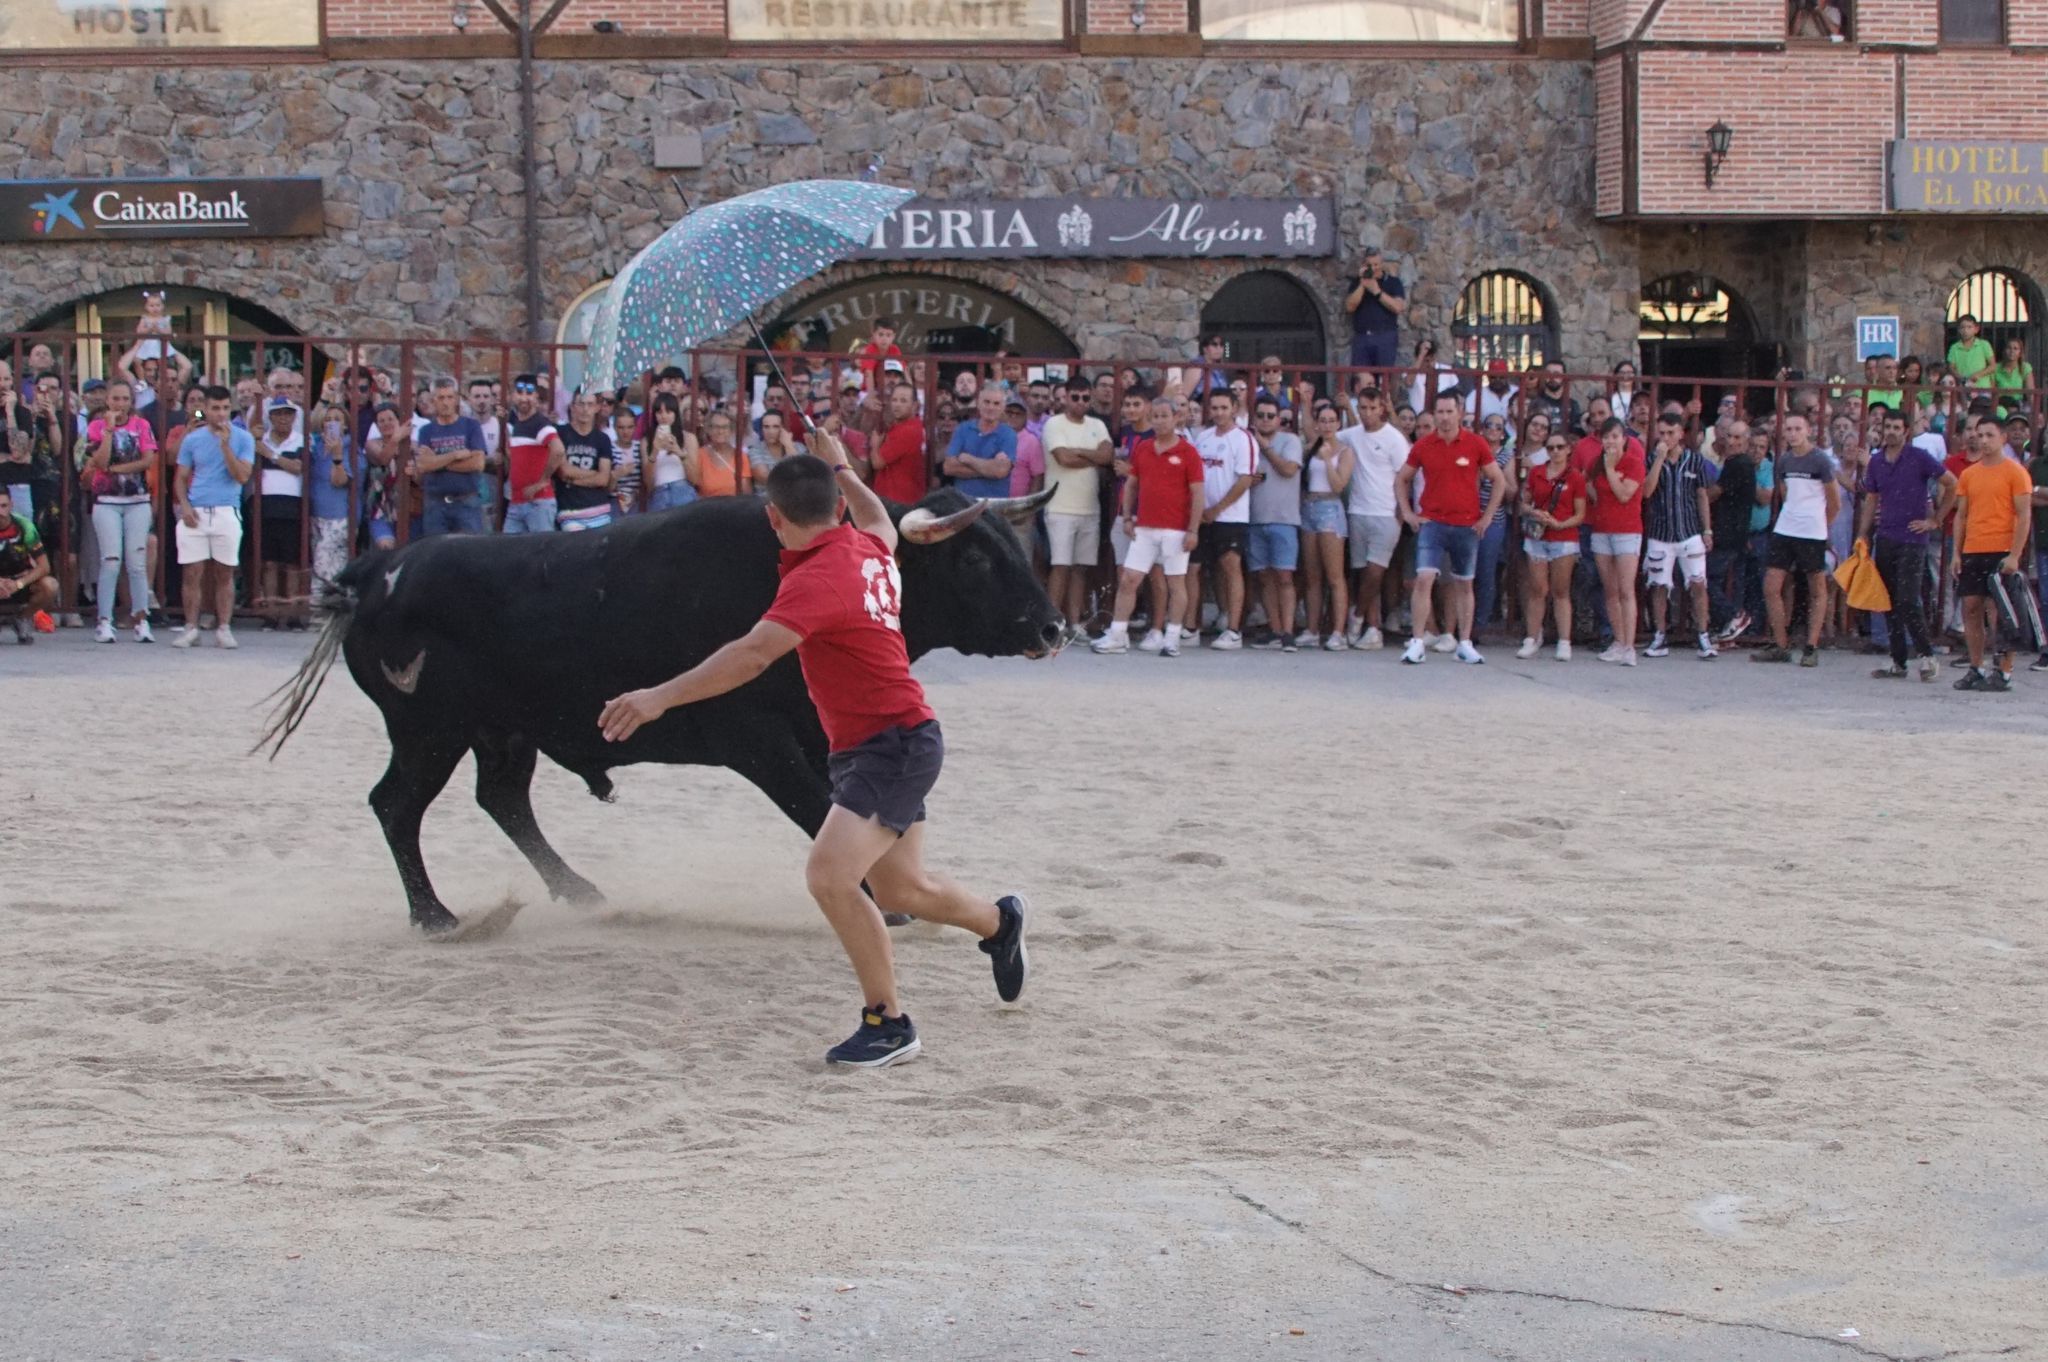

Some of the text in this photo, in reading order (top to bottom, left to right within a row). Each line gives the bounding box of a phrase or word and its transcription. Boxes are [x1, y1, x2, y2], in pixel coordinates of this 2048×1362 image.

[74, 8, 221, 34] HOSTAL
[764, 1, 1028, 28] RESTAURANTE
[1912, 146, 2030, 174] HOTEL
[93, 191, 249, 221] CaixaBank
[1109, 203, 1266, 252] Algón
[791, 289, 1018, 345] FRUTERIA
[1863, 323, 1894, 343] HR
